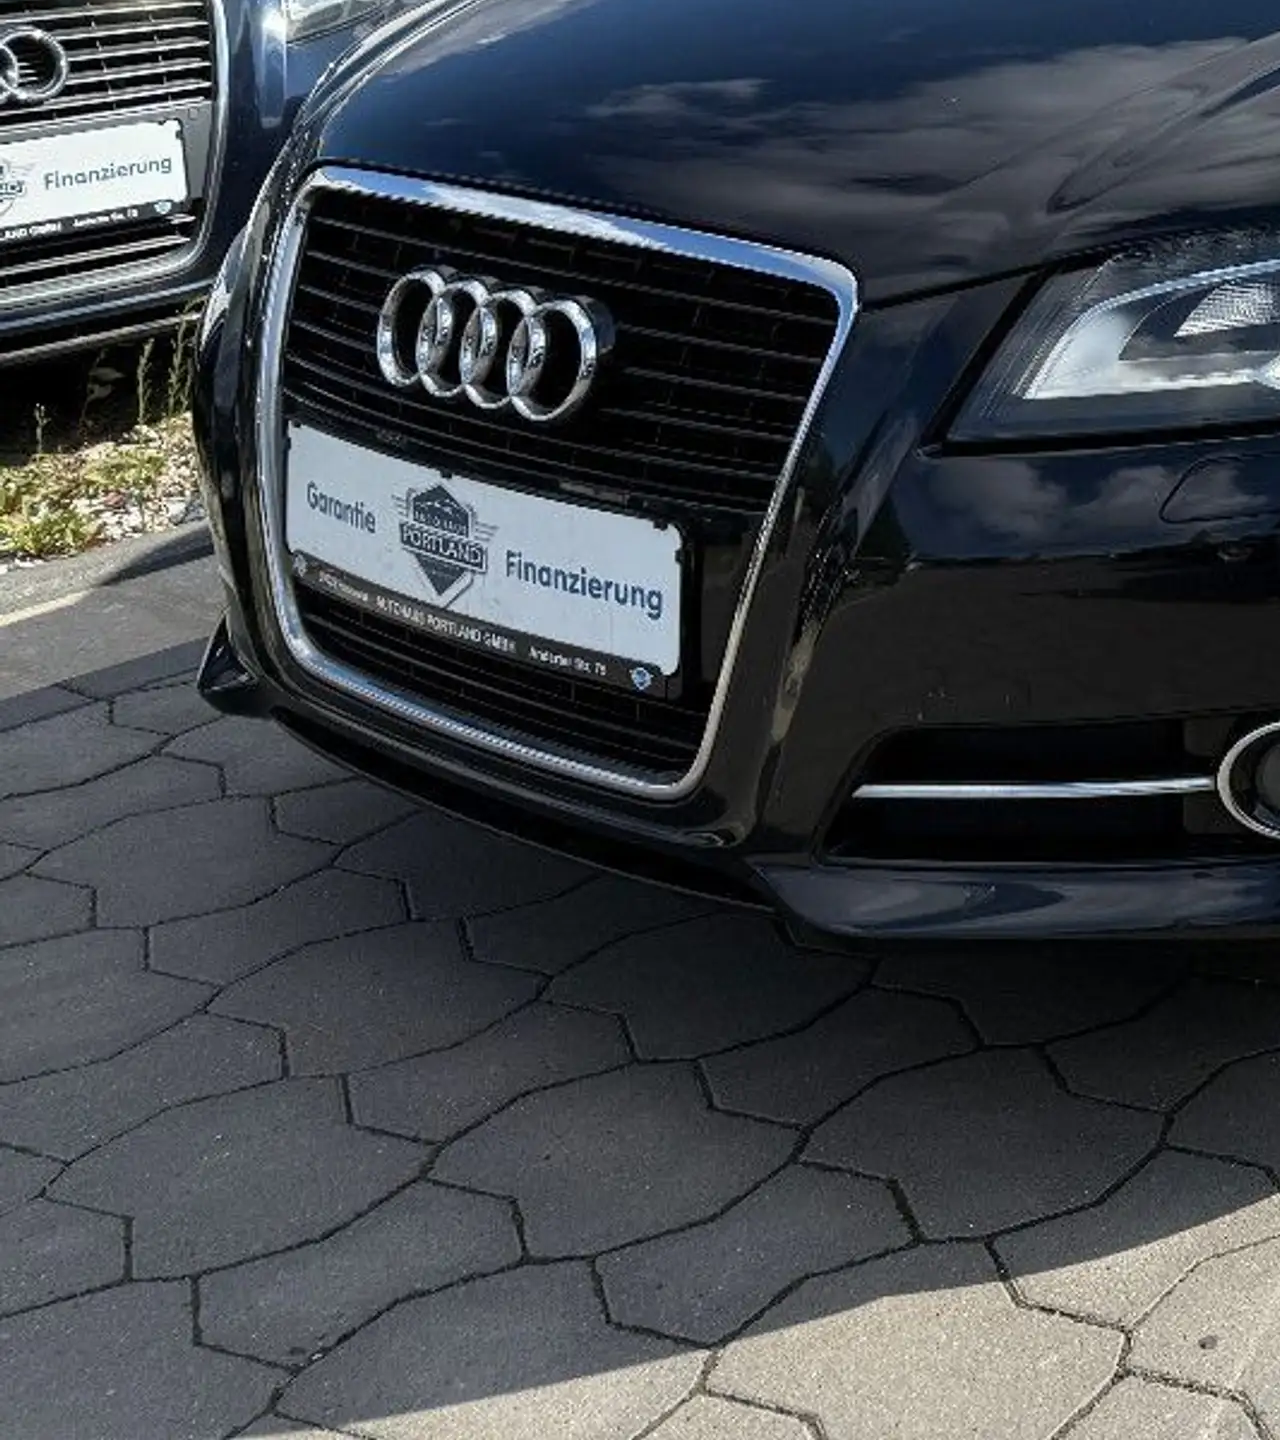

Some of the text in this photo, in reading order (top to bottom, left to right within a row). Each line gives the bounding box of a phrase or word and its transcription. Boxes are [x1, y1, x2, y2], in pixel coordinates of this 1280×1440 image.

[43, 157, 172, 190] Finanzierung
[306, 480, 376, 534] Garantie
[402, 524, 483, 563] PORTLAND
[505, 549, 664, 621] Finanzierung
